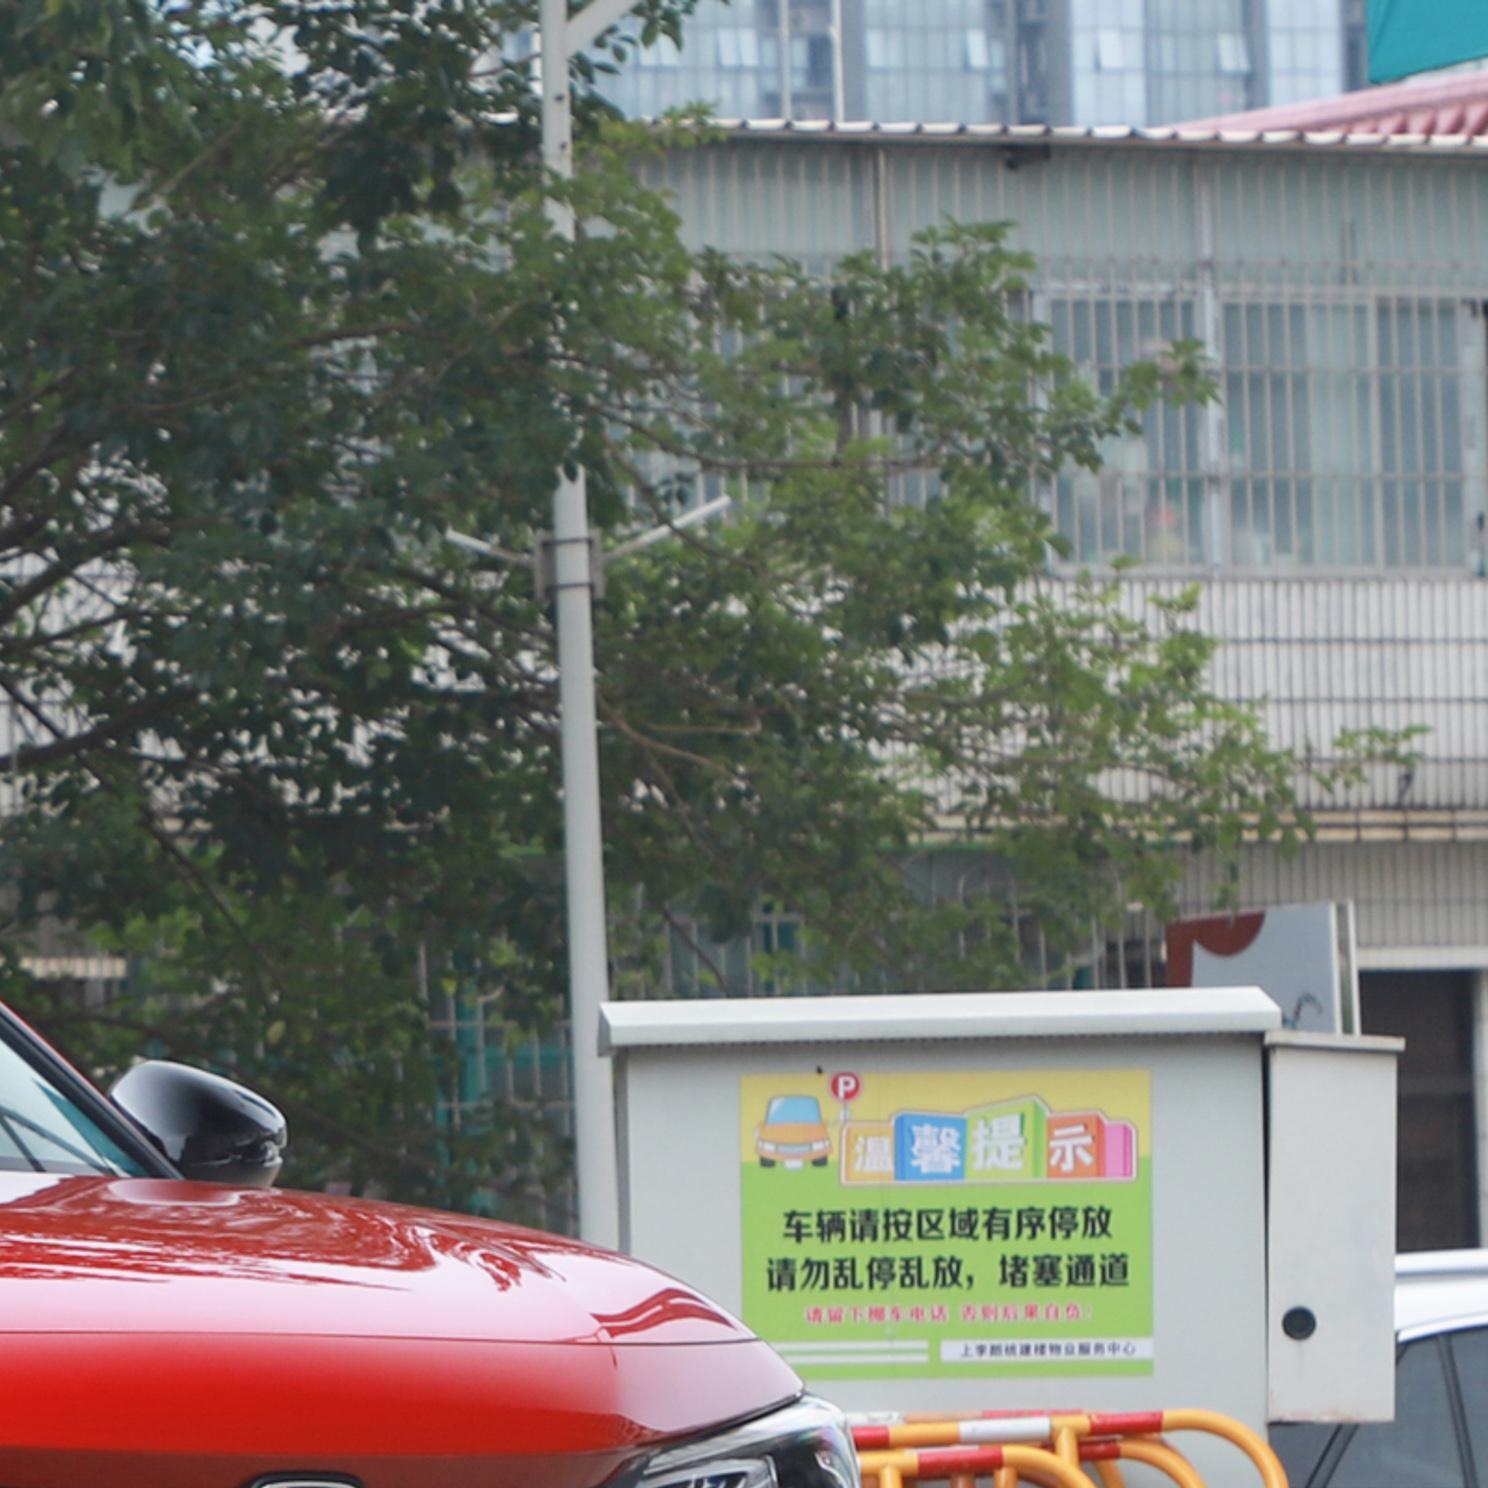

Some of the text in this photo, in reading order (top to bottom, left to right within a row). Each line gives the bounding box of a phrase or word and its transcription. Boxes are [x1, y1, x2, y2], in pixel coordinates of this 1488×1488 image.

[854, 1113, 1094, 1174] 温馨提示
[782, 1206, 1114, 1244] 车辆请按区域有序停放
[767, 1253, 1130, 1292] 请勿乱停乱放，堵塞通道
